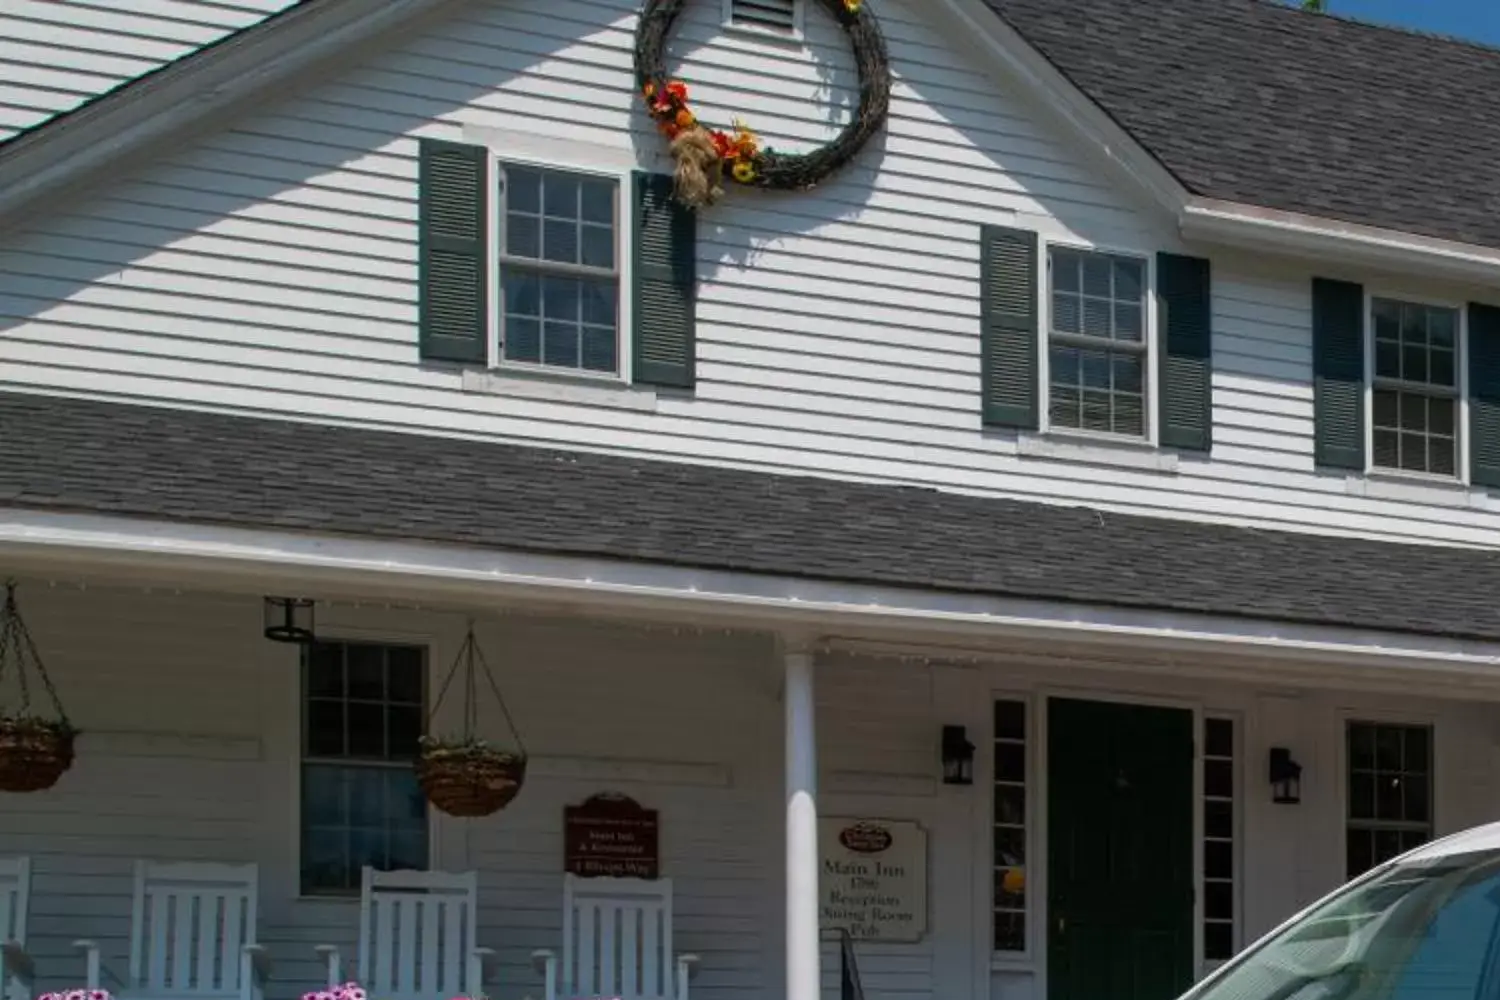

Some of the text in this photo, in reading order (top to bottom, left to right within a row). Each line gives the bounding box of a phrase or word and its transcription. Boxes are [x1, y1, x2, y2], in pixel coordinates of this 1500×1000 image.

[824, 859, 905, 877] Main Inn
[830, 890, 900, 907] Reception
[872, 907, 914, 921] Room
[851, 923, 880, 936] Pub
